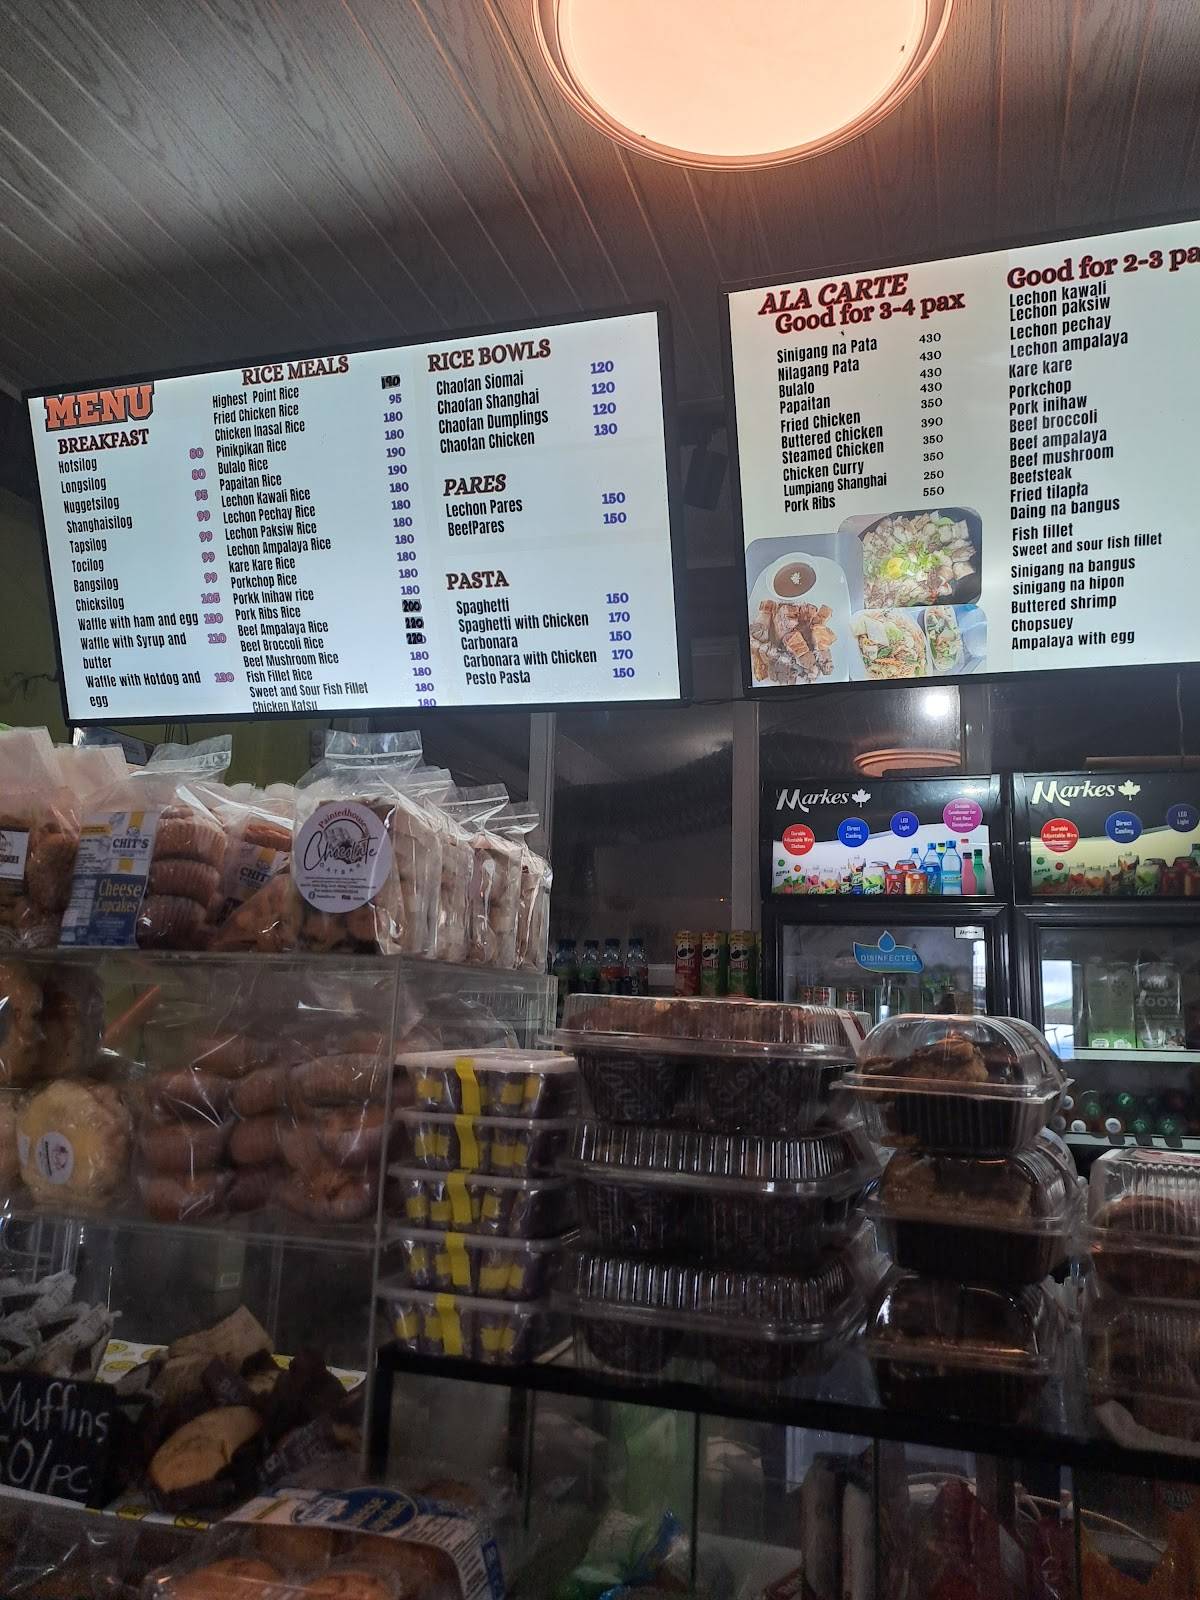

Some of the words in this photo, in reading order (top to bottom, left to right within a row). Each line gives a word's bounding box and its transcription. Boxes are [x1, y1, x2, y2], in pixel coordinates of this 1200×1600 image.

[1007, 258, 1075, 289] Good
[1078, 255, 1118, 279] for
[1123, 250, 1163, 273] 2-3
[757, 288, 812, 316] ALA
[818, 273, 909, 307] CARTE
[1010, 289, 1057, 307] Lechon
[1062, 280, 1106, 300] kawali
[775, 305, 839, 334] Good
[839, 303, 875, 325] for
[879, 298, 916, 320] 3-4
[920, 293, 966, 320] pax
[919, 332, 941, 344] 430
[1010, 341, 1057, 358] Lechon
[1062, 332, 1128, 352] ampalaya
[427, 349, 475, 372] RICE
[478, 338, 551, 366] BOWLS
[777, 345, 828, 364] Sinigang
[832, 343, 847, 356] na
[851, 337, 877, 353] Pata
[241, 364, 284, 386] RICE
[287, 356, 349, 380] MEALS
[590, 360, 614, 374] 120
[778, 363, 829, 382] Nilagang
[833, 358, 859, 374] Pata
[1009, 363, 1038, 379] Kare
[1043, 359, 1072, 374] kare
[436, 377, 482, 396] Chaofan
[485, 370, 524, 390] Siomai
[779, 381, 815, 399] Bulalo
[1009, 380, 1071, 399] Porkchop
[44, 381, 154, 432] MENU
[212, 392, 247, 409] Highest
[252, 388, 277, 403] Point
[279, 386, 299, 400] Rice
[389, 393, 402, 405] 95
[437, 397, 483, 415] Chaofan
[486, 388, 539, 409] Shanghai
[780, 396, 830, 415] Papaitan
[921, 397, 943, 409] 350
[1009, 400, 1039, 416] Pork
[1043, 395, 1087, 412] inihaw
[213, 410, 236, 425] Fried
[239, 407, 276, 422] Chicken
[279, 403, 299, 417] Rice
[383, 411, 403, 423] 180
[780, 416, 809, 433] Fried
[813, 412, 861, 429] Chicken
[921, 417, 943, 428] 390
[1009, 416, 1037, 433] Beef
[1042, 409, 1097, 429] broccoli
[215, 426, 252, 442] Chicken
[254, 421, 283, 437] Inasal
[285, 419, 305, 434] Rice
[594, 423, 618, 436] 130
[781, 430, 831, 449] Buttered
[835, 425, 883, 442] chicken
[57, 428, 149, 455] BREAKFAST
[216, 442, 264, 458] Pinikpikan
[266, 438, 287, 453] Rice
[440, 436, 486, 453] Chaofan
[488, 431, 535, 449] Chicken
[1010, 435, 1038, 451] Beef
[1042, 429, 1107, 448] ampalaya
[189, 447, 204, 460] 80
[386, 446, 406, 458] 190
[782, 445, 832, 464] Steamed
[836, 441, 884, 458] Chicken
[58, 458, 97, 474] Hotsilog
[783, 465, 829, 481] Chicken
[833, 461, 864, 476] Curry
[923, 470, 944, 480] 250
[1010, 466, 1072, 485] Beefsteak
[61, 477, 107, 494] Longsilog
[443, 473, 506, 497] PARES
[784, 480, 834, 498] Lumpiang
[837, 472, 887, 491] Shanghai
[923, 486, 945, 497] 550
[63, 496, 120, 514] Nuggetsilog
[194, 489, 209, 502] 95
[602, 492, 626, 504] 150
[784, 498, 810, 513] Pork
[812, 495, 836, 510] Ribs
[196, 510, 211, 522] 99
[446, 501, 487, 518] Lechon
[490, 499, 523, 514] Pares
[1010, 504, 1046, 520] Daing
[1051, 503, 1066, 516] na
[1071, 498, 1120, 514] bangus
[66, 515, 133, 534] Shanghaisilog
[69, 538, 107, 554] Tapsilog
[1012, 542, 1047, 557] Sweet
[1051, 540, 1072, 554] and
[1076, 539, 1103, 552] sour
[1107, 535, 1130, 549] fish
[1134, 532, 1162, 547] fillet
[71, 558, 104, 573] Tocilog
[1011, 563, 1064, 578] Sinigang
[1069, 562, 1084, 574] na
[1088, 557, 1135, 572] bangus
[73, 577, 119, 592] Bangsilog
[230, 575, 275, 589] Porkchop
[276, 573, 297, 586] Rice
[445, 570, 510, 590] PASTA
[75, 596, 124, 612] Chicksilog
[1011, 597, 1066, 614] Buttered
[1070, 594, 1117, 610] shrimp
[77, 617, 107, 631] Waffle
[109, 615, 131, 629] with
[133, 615, 155, 628] ham
[158, 613, 177, 627] and
[179, 613, 199, 626] egg
[458, 615, 512, 634] Spaghetti
[514, 614, 540, 630] with
[543, 613, 589, 628] Chicken
[608, 611, 630, 623] 170
[1011, 617, 1073, 632] Chopsuey
[240, 639, 261, 652] Beef
[262, 637, 302, 651] Broccoli
[303, 636, 324, 649] Rice
[461, 636, 518, 650] Carbonara
[1011, 635, 1073, 651] Ampalaya
[1078, 631, 1106, 645] with
[1111, 631, 1135, 644] egg
[466, 671, 497, 685] Pesto
[499, 670, 531, 684] Pasta
[612, 667, 635, 678] 150
[249, 685, 278, 698] Sweet
[280, 684, 298, 697] and
[299, 684, 320, 696] Sour
[322, 683, 343, 695] Fish
[344, 682, 369, 694] Fillet
[775, 788, 850, 813] Markes
[1031, 780, 1115, 807] Markes
[112, 838, 150, 849] CHIT'S
[98, 879, 142, 897] Cheese
[860, 954, 918, 962] DISINFECTED
